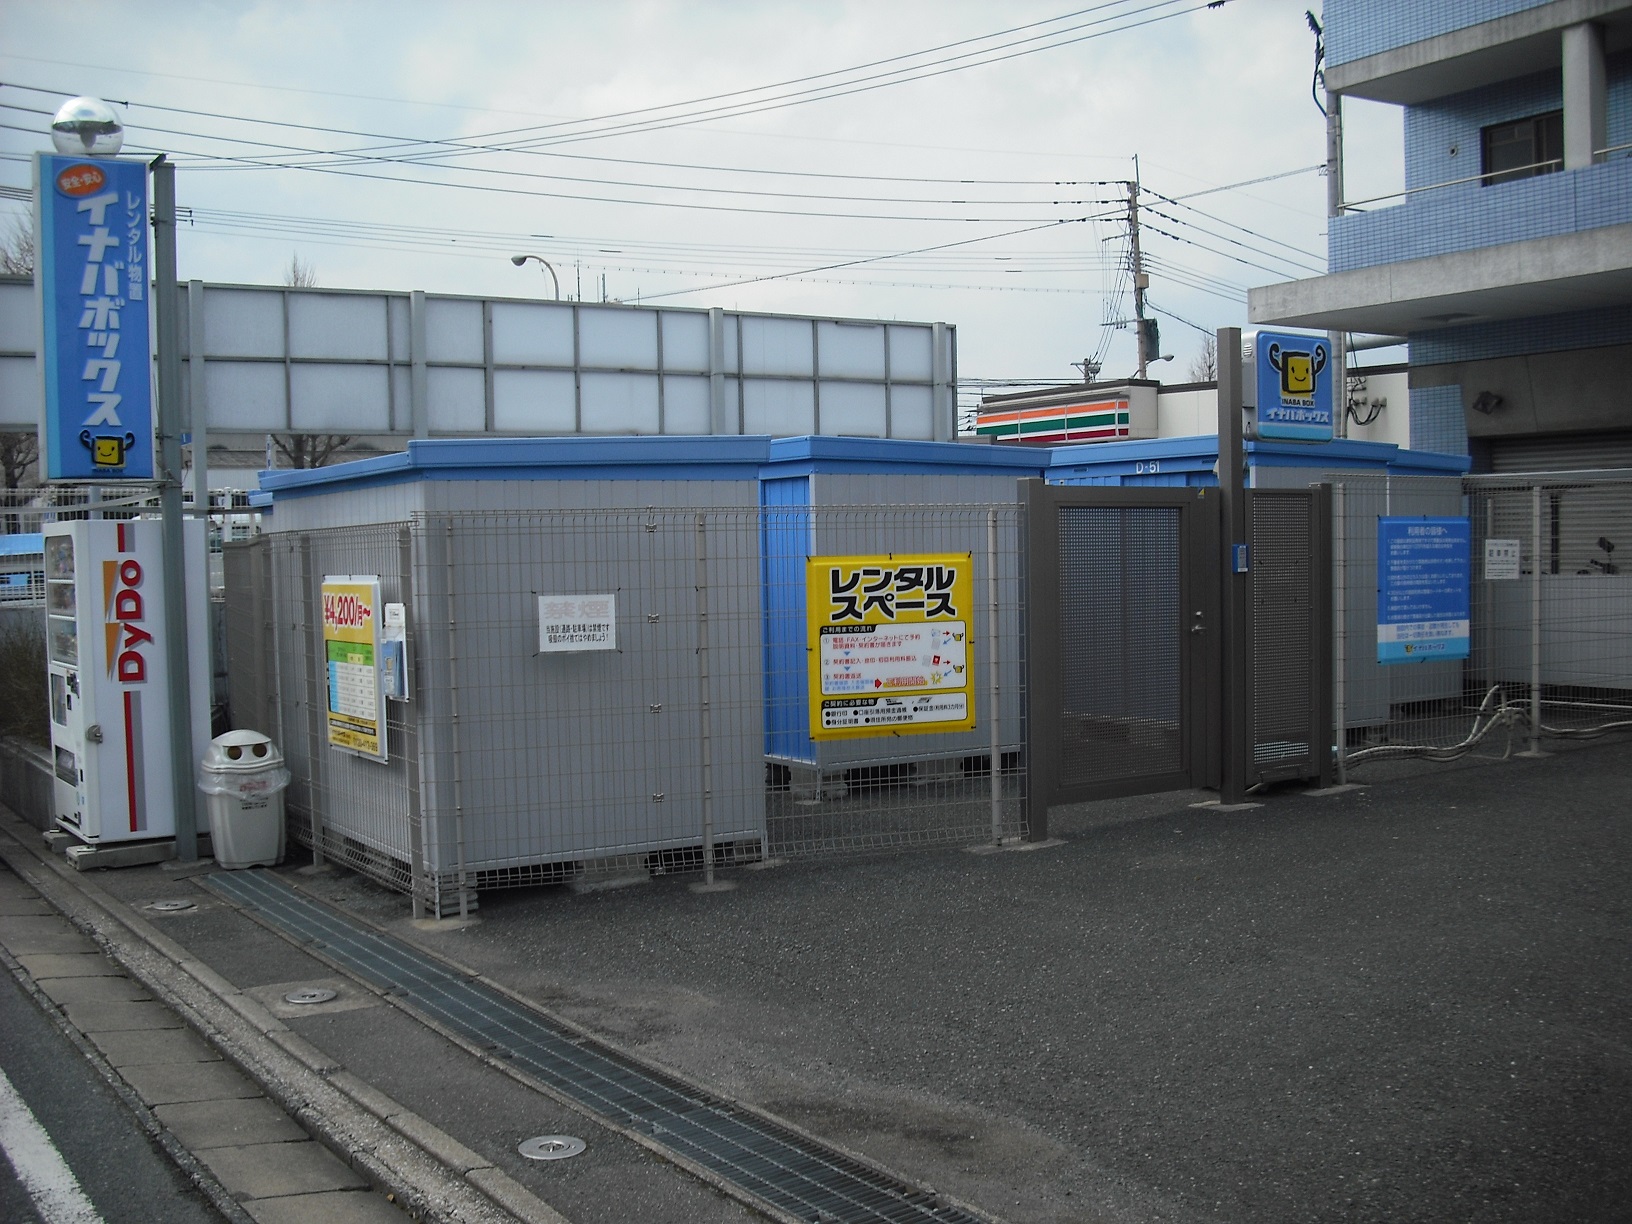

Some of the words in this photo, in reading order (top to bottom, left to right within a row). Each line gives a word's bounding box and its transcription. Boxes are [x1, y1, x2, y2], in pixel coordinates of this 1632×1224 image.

[126, 190, 143, 301] レンタル物置
[77, 192, 126, 427] イナバボックス
[1281, 398, 1301, 406] INABA
[1302, 399, 1315, 407] BOX
[1266, 407, 1329, 423] イナバボックス
[1136, 460, 1160, 474] D-51
[831, 567, 956, 594] レンタル
[543, 600, 610, 620] 禁煙
[831, 593, 956, 621] スペース
[115, 559, 151, 682] DyDo
[822, 625, 873, 634] ご利用までの流れ
